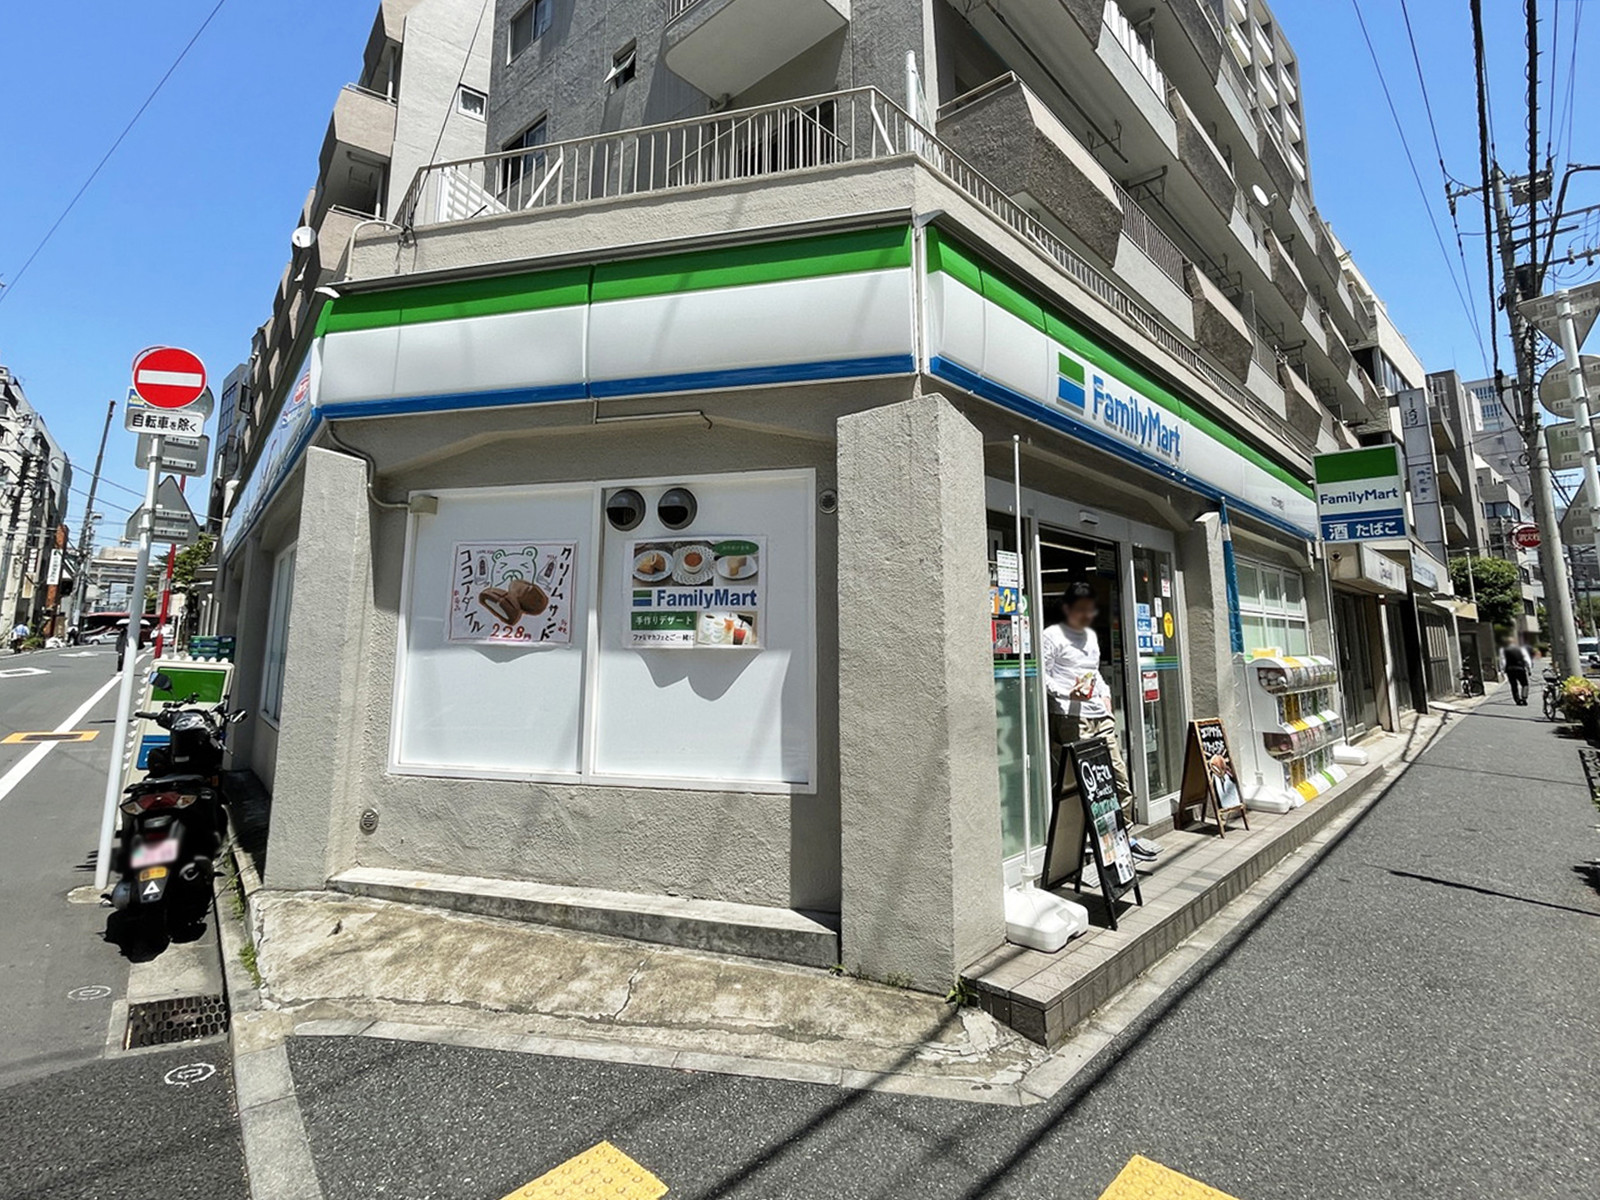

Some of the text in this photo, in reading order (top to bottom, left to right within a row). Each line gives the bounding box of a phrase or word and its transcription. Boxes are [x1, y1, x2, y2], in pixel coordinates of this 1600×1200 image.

[132, 414, 197, 432] 自転車を除く
[1093, 374, 1180, 457] FamilyMart
[1320, 488, 1399, 505] FamilyMart
[1329, 522, 1398, 540] 酒 たばこ
[656, 589, 757, 609] FamilyMart
[635, 615, 692, 626] 手作りデザート
